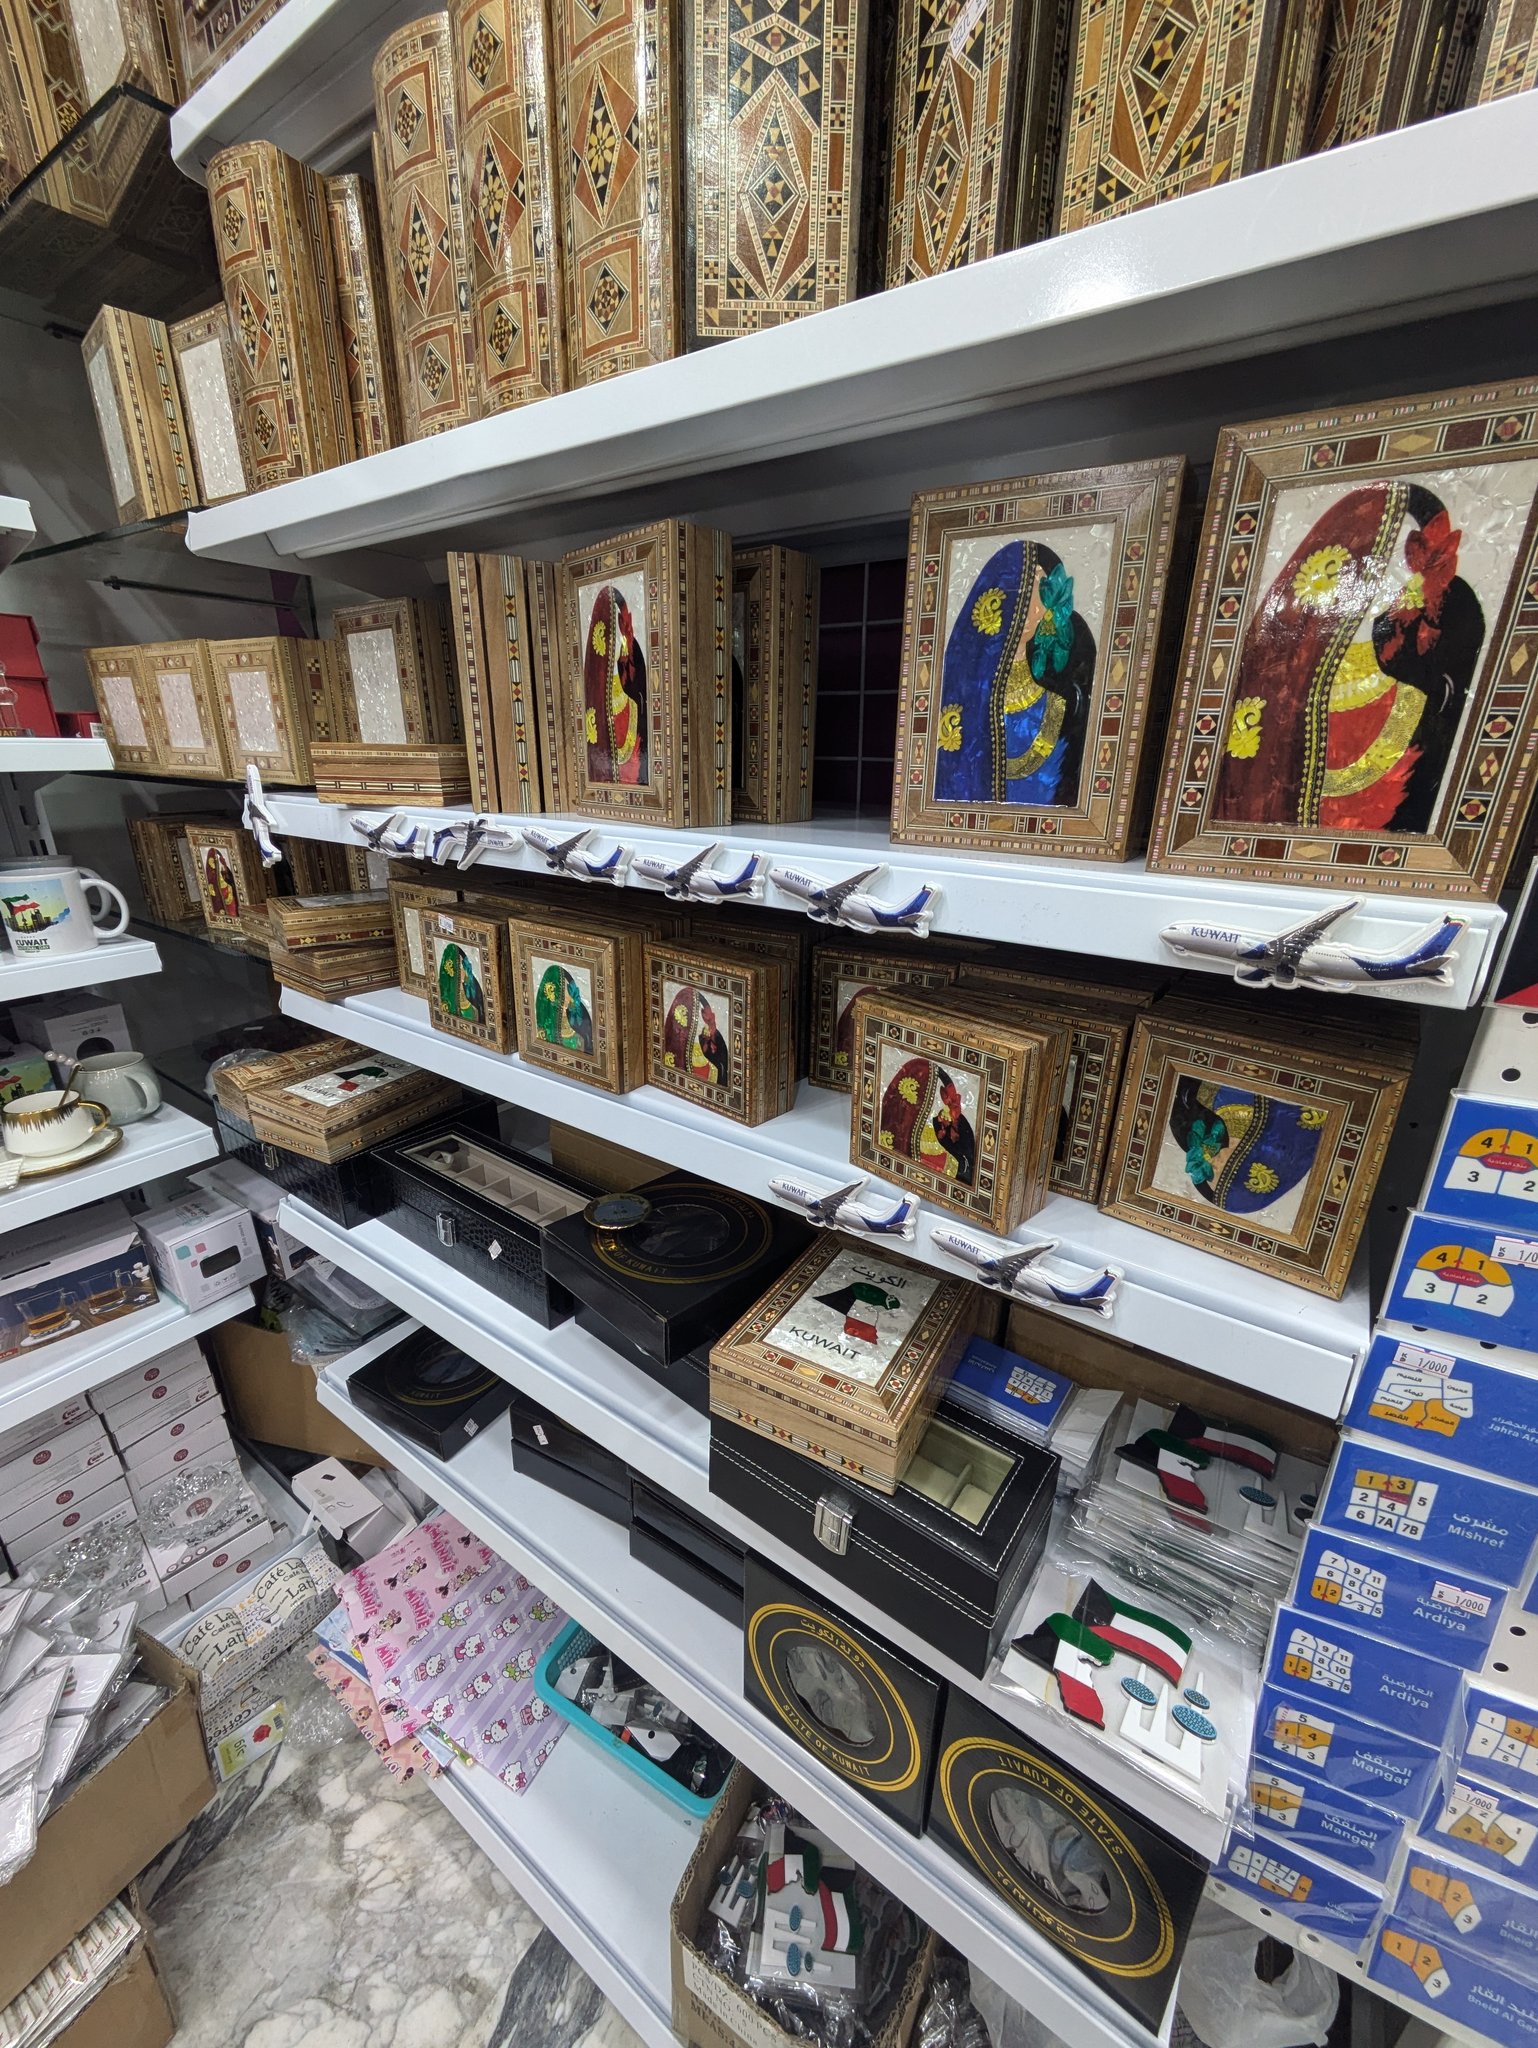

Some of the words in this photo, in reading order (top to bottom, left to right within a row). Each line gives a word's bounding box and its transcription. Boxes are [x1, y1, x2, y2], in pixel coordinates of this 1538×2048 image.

[531, 829, 549, 845] KUWAIT
[643, 858, 666, 871] KUWAIT
[784, 870, 813, 888] KUWAIT
[1191, 926, 1242, 944] KUWAIT
[15, 938, 48, 947] KUWAIT
[301, 1084, 336, 1098] KUWAIT
[1481, 1137, 1493, 1148] 4
[1526, 1143, 1533, 1154] 1
[1467, 1171, 1480, 1183] 3
[781, 1181, 808, 1198] KUWAIT
[1523, 1181, 1536, 1192] 2
[948, 1234, 981, 1256] KUWAIT
[1436, 1252, 1447, 1263] 4
[625, 1257, 669, 1275] KUWAIT
[1478, 1260, 1485, 1270] 1
[851, 1264, 908, 1290] الكويت
[1424, 1283, 1436, 1293] 3
[1476, 1294, 1488, 1304] 2
[787, 1325, 862, 1360] KUWAIT
[1417, 1358, 1448, 1373] 1/000
[1488, 1424, 1520, 1438] Jahra
[1368, 1476, 1374, 1485] 1
[1396, 1480, 1407, 1491] 3
[1359, 1492, 1369, 1502] 2
[1417, 1496, 1428, 1507] 5
[1387, 1502, 1396, 1511] 4
[1356, 1510, 1366, 1520] 6
[1378, 1515, 1394, 1528] 7A
[1402, 1523, 1419, 1536] 7B
[1452, 1512, 1509, 1536] مشرف
[1448, 1524, 1505, 1549] Mishref
[257, 1567, 285, 1600] Café
[405, 1588, 431, 1630] MINNIE
[1455, 1595, 1484, 1612] 1/000
[1413, 1607, 1467, 1632] Ardiya
[184, 1620, 215, 1656] Café
[1382, 1673, 1434, 1698] العارضية
[1380, 1685, 1430, 1709] Ardiya
[1298, 1714, 1308, 1723] 5
[1308, 1733, 1317, 1741] 4
[1514, 1727, 1522, 1735] 3
[783, 1703, 812, 1739] STATE
[815, 1739, 828, 1752] OF
[832, 1751, 870, 1777] KUWAIT
[1307, 1752, 1316, 1760] 3
[1355, 1750, 1413, 1778] المنقف
[1351, 1757, 1410, 1787] Mangaf
[1270, 1778, 1279, 1786] 5
[999, 1755, 1049, 1787] KUWAIT
[1055, 1787, 1075, 1804] OF
[1079, 1808, 1123, 1855] STATE
[1466, 1793, 1492, 1810] 1/000
[1278, 1812, 1287, 1821] 3
[1320, 1820, 1376, 1849] Mangaf
[1464, 1826, 1472, 1834] 4
[1515, 1827, 1522, 1835] 1
[1496, 1837, 1504, 1846] 5
[1425, 1879, 1430, 1887] 1
[1453, 1893, 1462, 1902] 2
[1463, 1915, 1472, 1924] 3
[1499, 1929, 1534, 1949] Bneid
[1422, 1956, 1431, 1966] 2
[1432, 1979, 1442, 1989] 3
[1467, 1994, 1500, 2015] Bneid
[1502, 2012, 1515, 2022] Al
